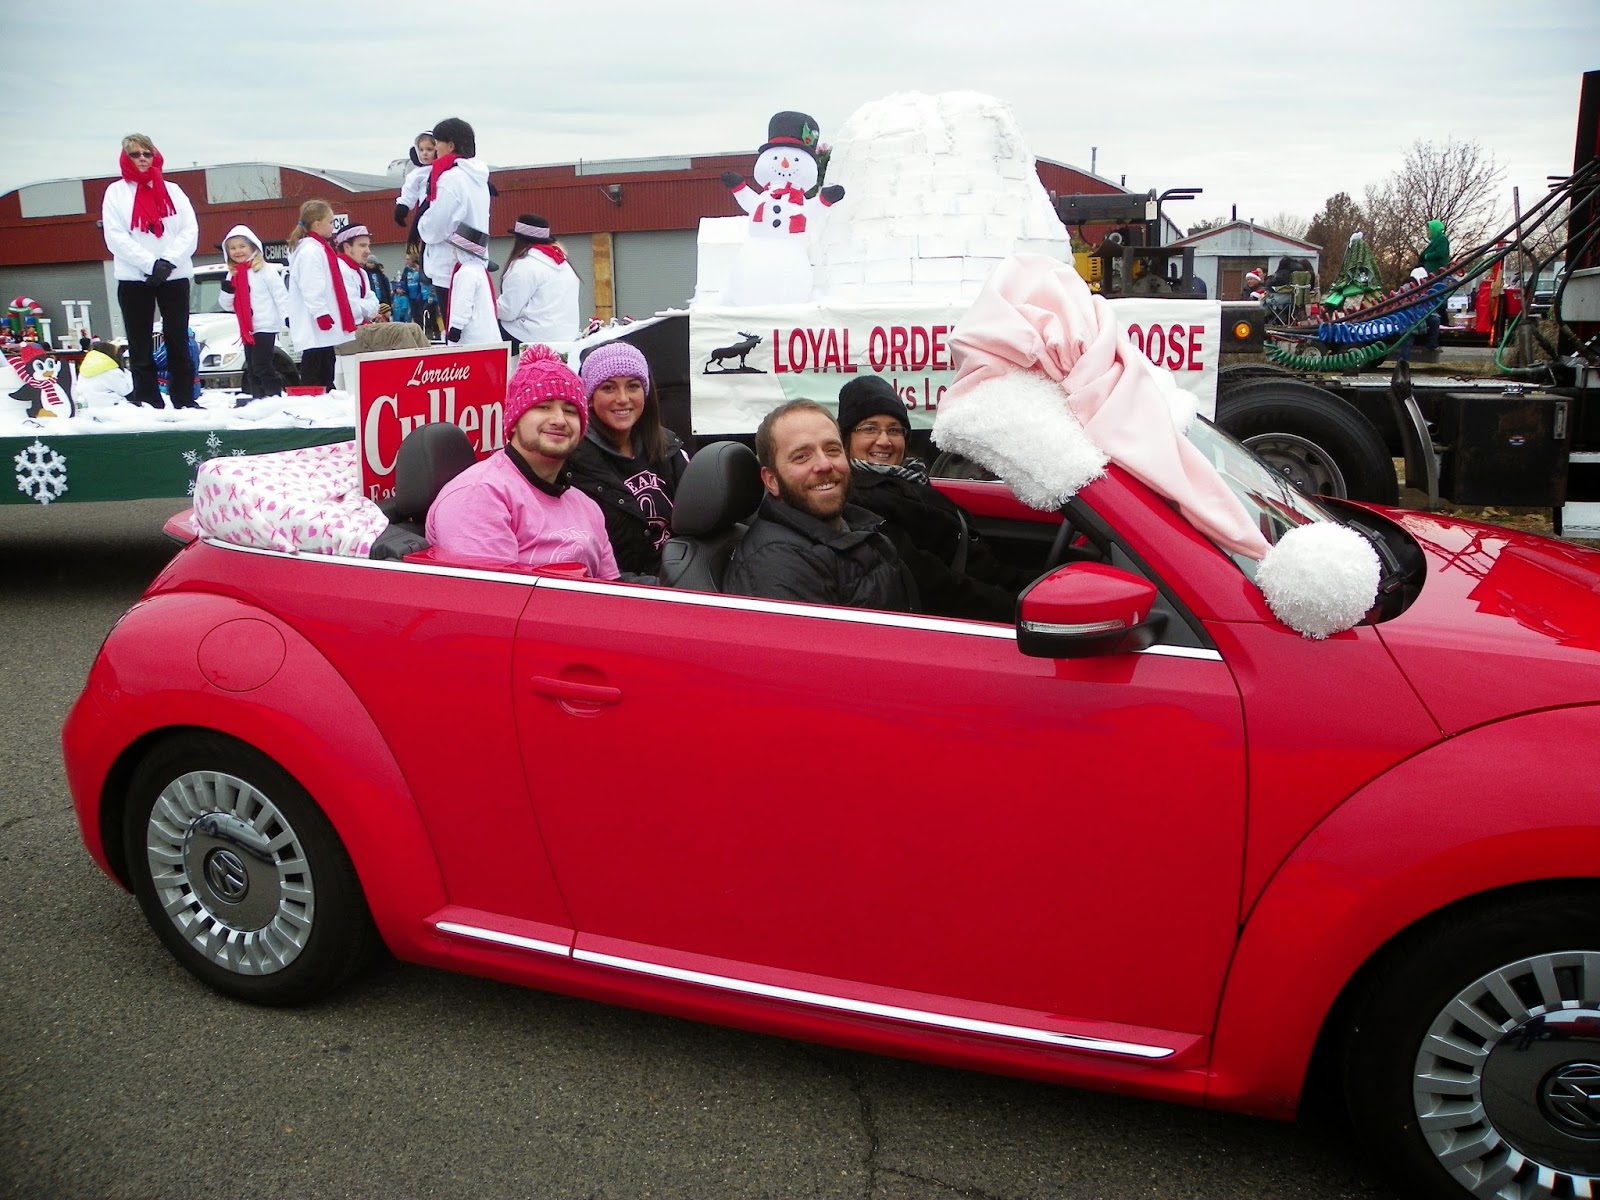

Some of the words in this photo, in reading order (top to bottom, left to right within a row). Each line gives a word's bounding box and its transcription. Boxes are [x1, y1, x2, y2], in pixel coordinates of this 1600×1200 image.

[406, 359, 471, 387] Lorraine
[773, 328, 858, 374] LOYAL
[869, 325, 956, 373] ORDE
[1127, 323, 1205, 371] OOSE
[364, 386, 506, 476] Cullen
